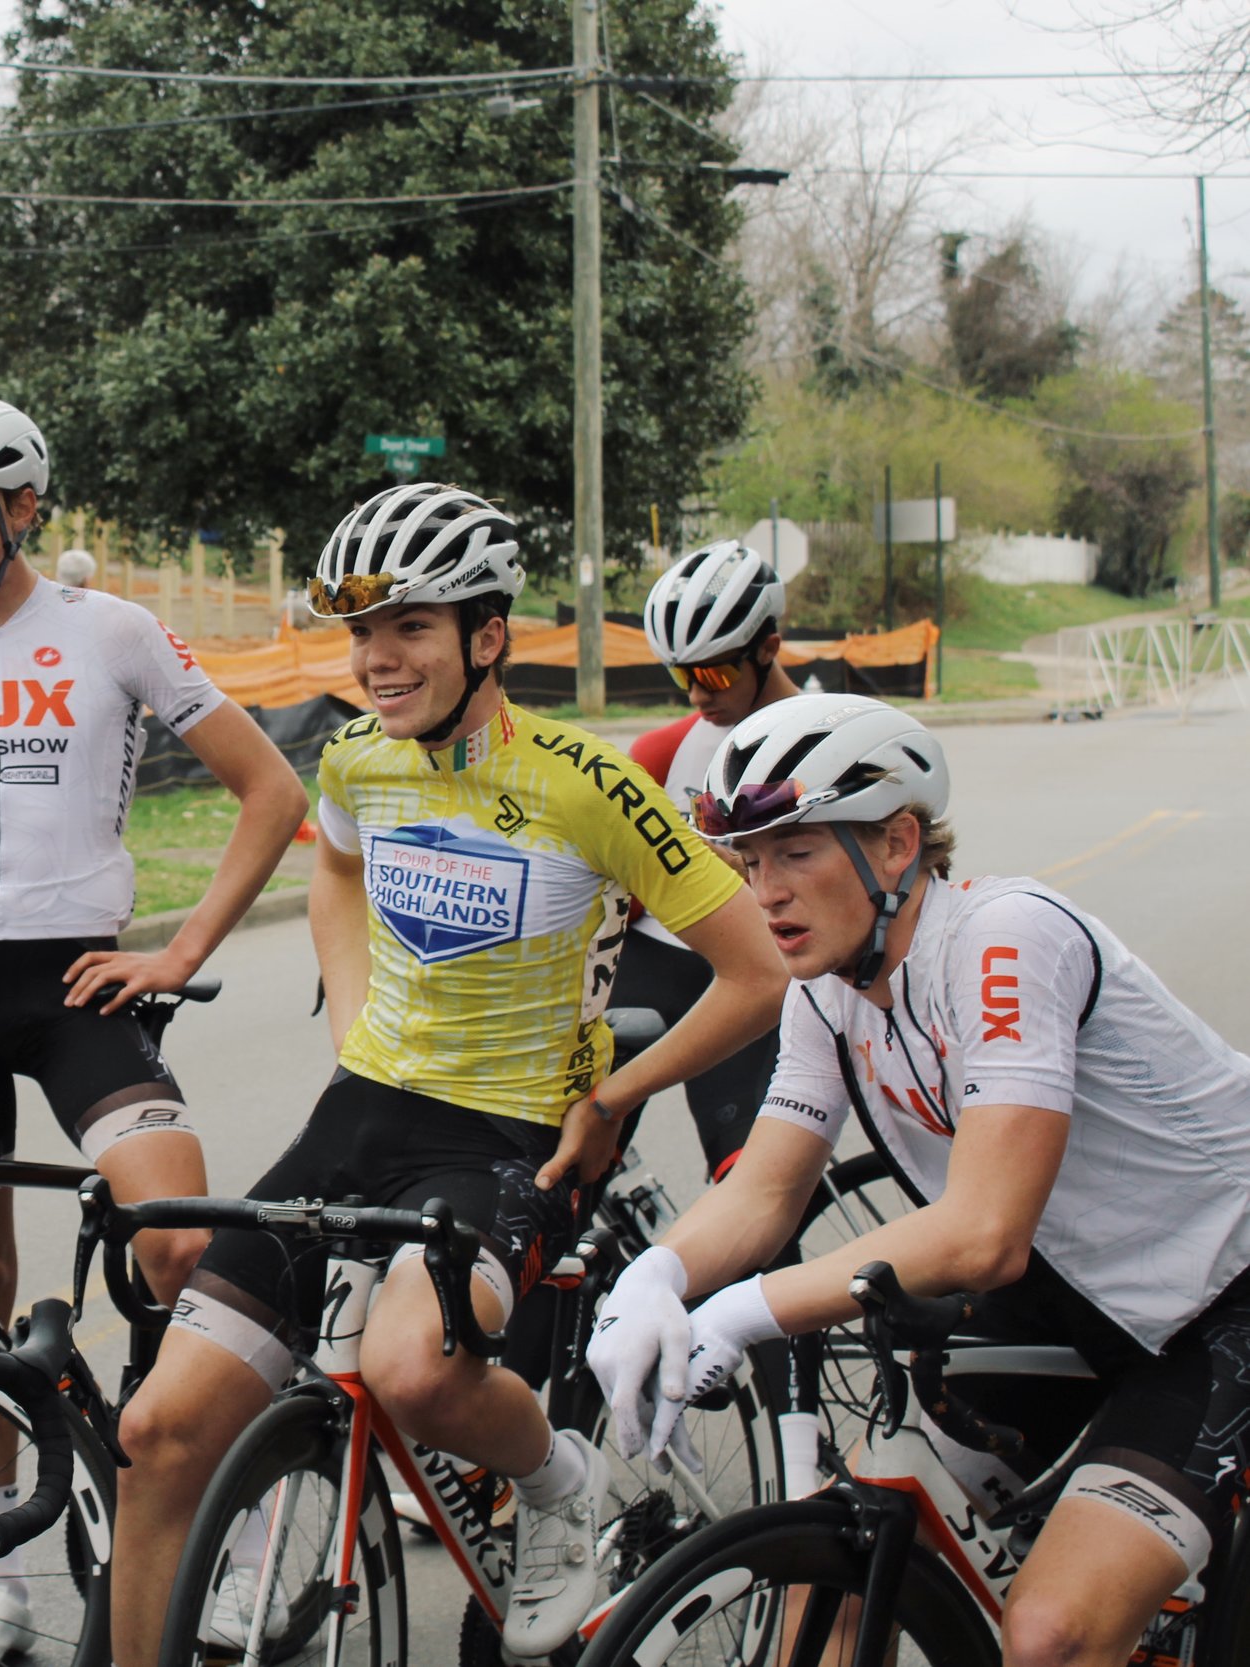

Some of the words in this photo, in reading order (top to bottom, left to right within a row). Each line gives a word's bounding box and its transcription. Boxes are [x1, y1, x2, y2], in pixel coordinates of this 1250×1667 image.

[437, 557, 490, 598] S-WORKS
[532, 733, 691, 876] JAKROO
[379, 865, 507, 906] SOUTHERN
[393, 850, 430, 869] TOUR
[435, 858, 459, 874] OF
[462, 863, 493, 881] THE
[375, 884, 511, 929] HIGHLANDS
[981, 946, 1022, 1043] LUX
[413, 1443, 516, 1590] WORKS
